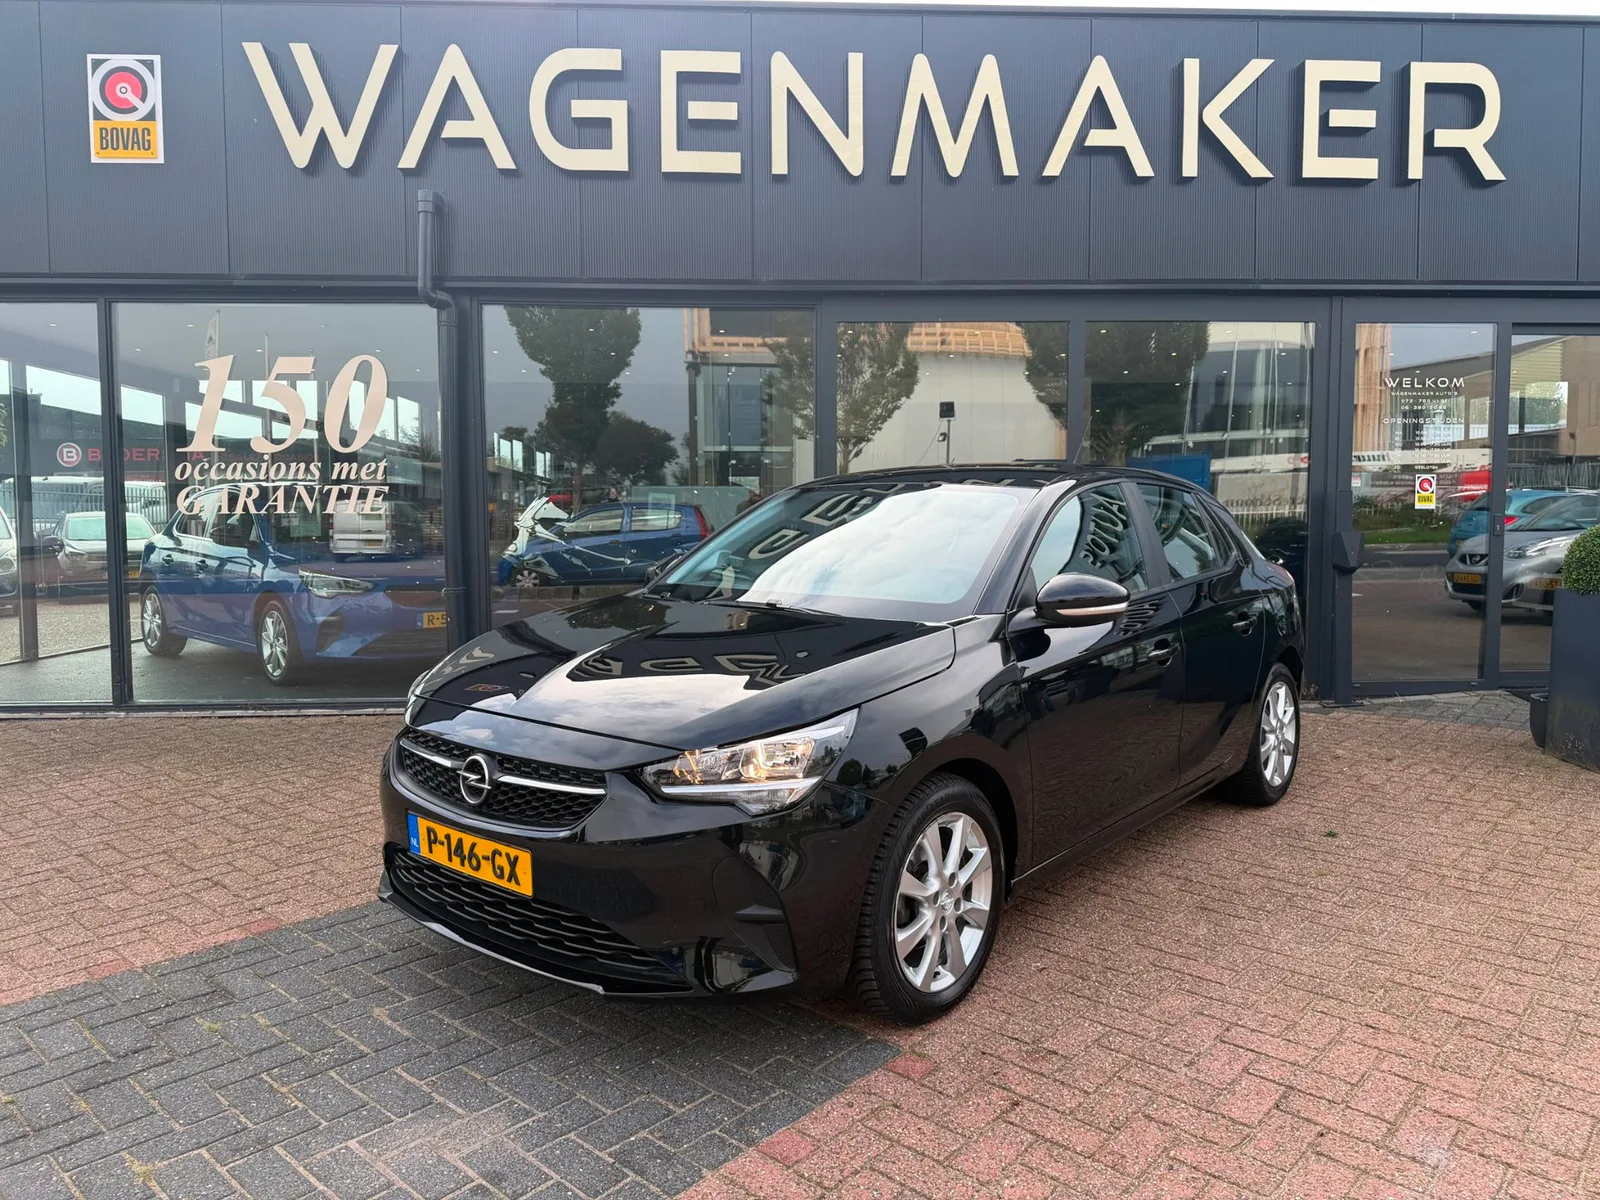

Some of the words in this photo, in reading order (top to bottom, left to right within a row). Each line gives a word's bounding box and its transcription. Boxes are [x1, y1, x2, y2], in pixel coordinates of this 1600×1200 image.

[242, 42, 1506, 182] WAGENMAKER
[99, 127, 152, 151] BOVAG
[1384, 377, 1465, 388] WELKOM
[176, 354, 388, 453] 150
[174, 454, 321, 481] occasions
[332, 458, 388, 481] met
[176, 485, 390, 515] GARANTIE
[425, 826, 521, 886] P-146-GX
